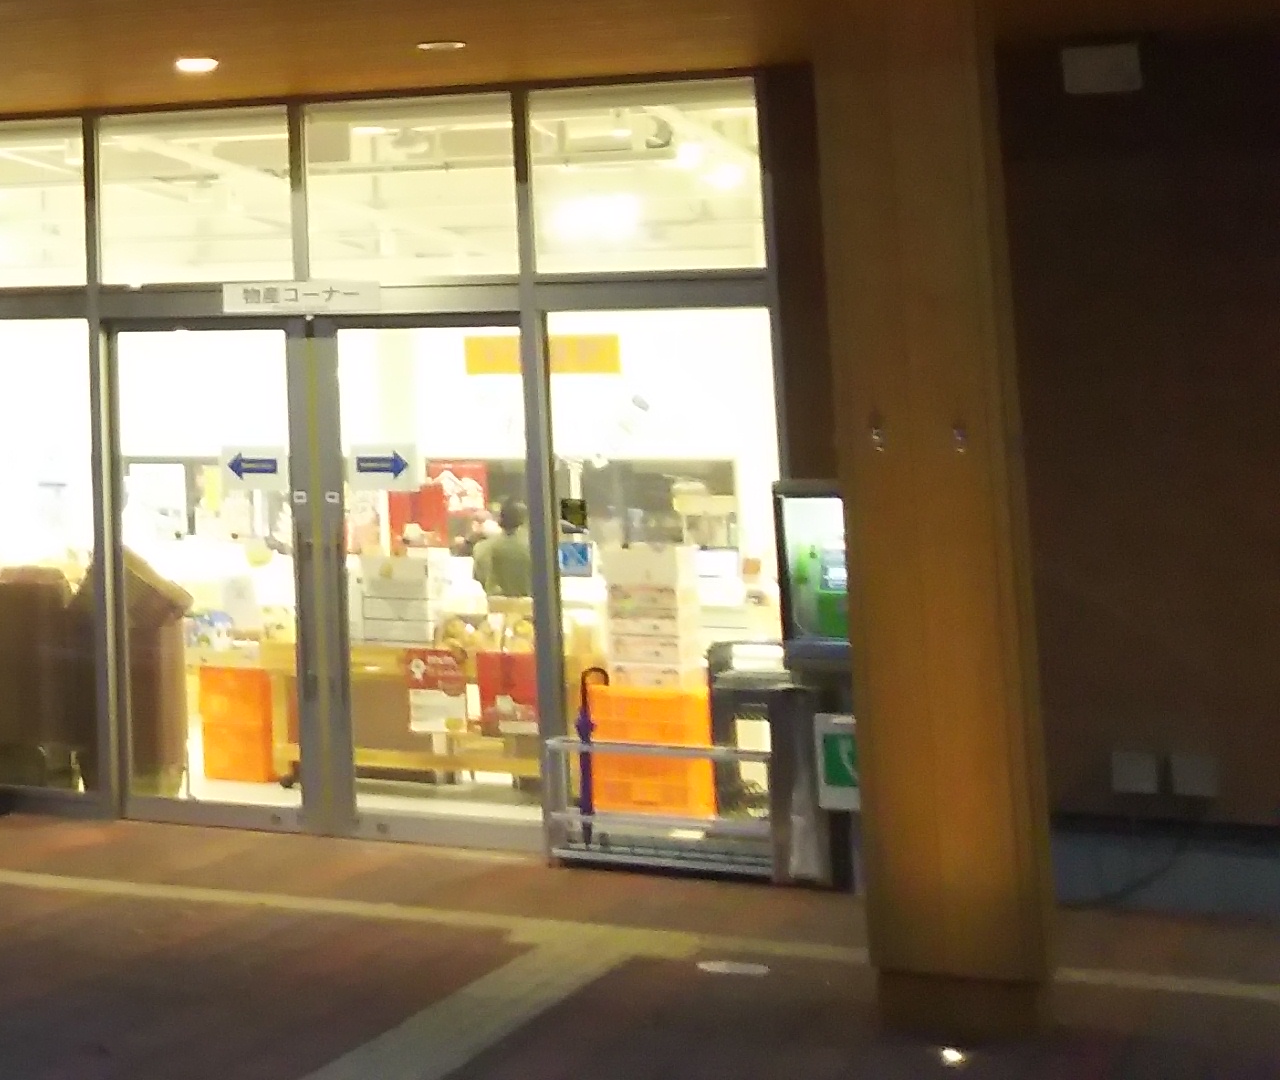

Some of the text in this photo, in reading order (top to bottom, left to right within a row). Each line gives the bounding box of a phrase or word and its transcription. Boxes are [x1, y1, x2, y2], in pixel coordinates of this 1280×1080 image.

[243, 286, 359, 304] 物産コーナー
